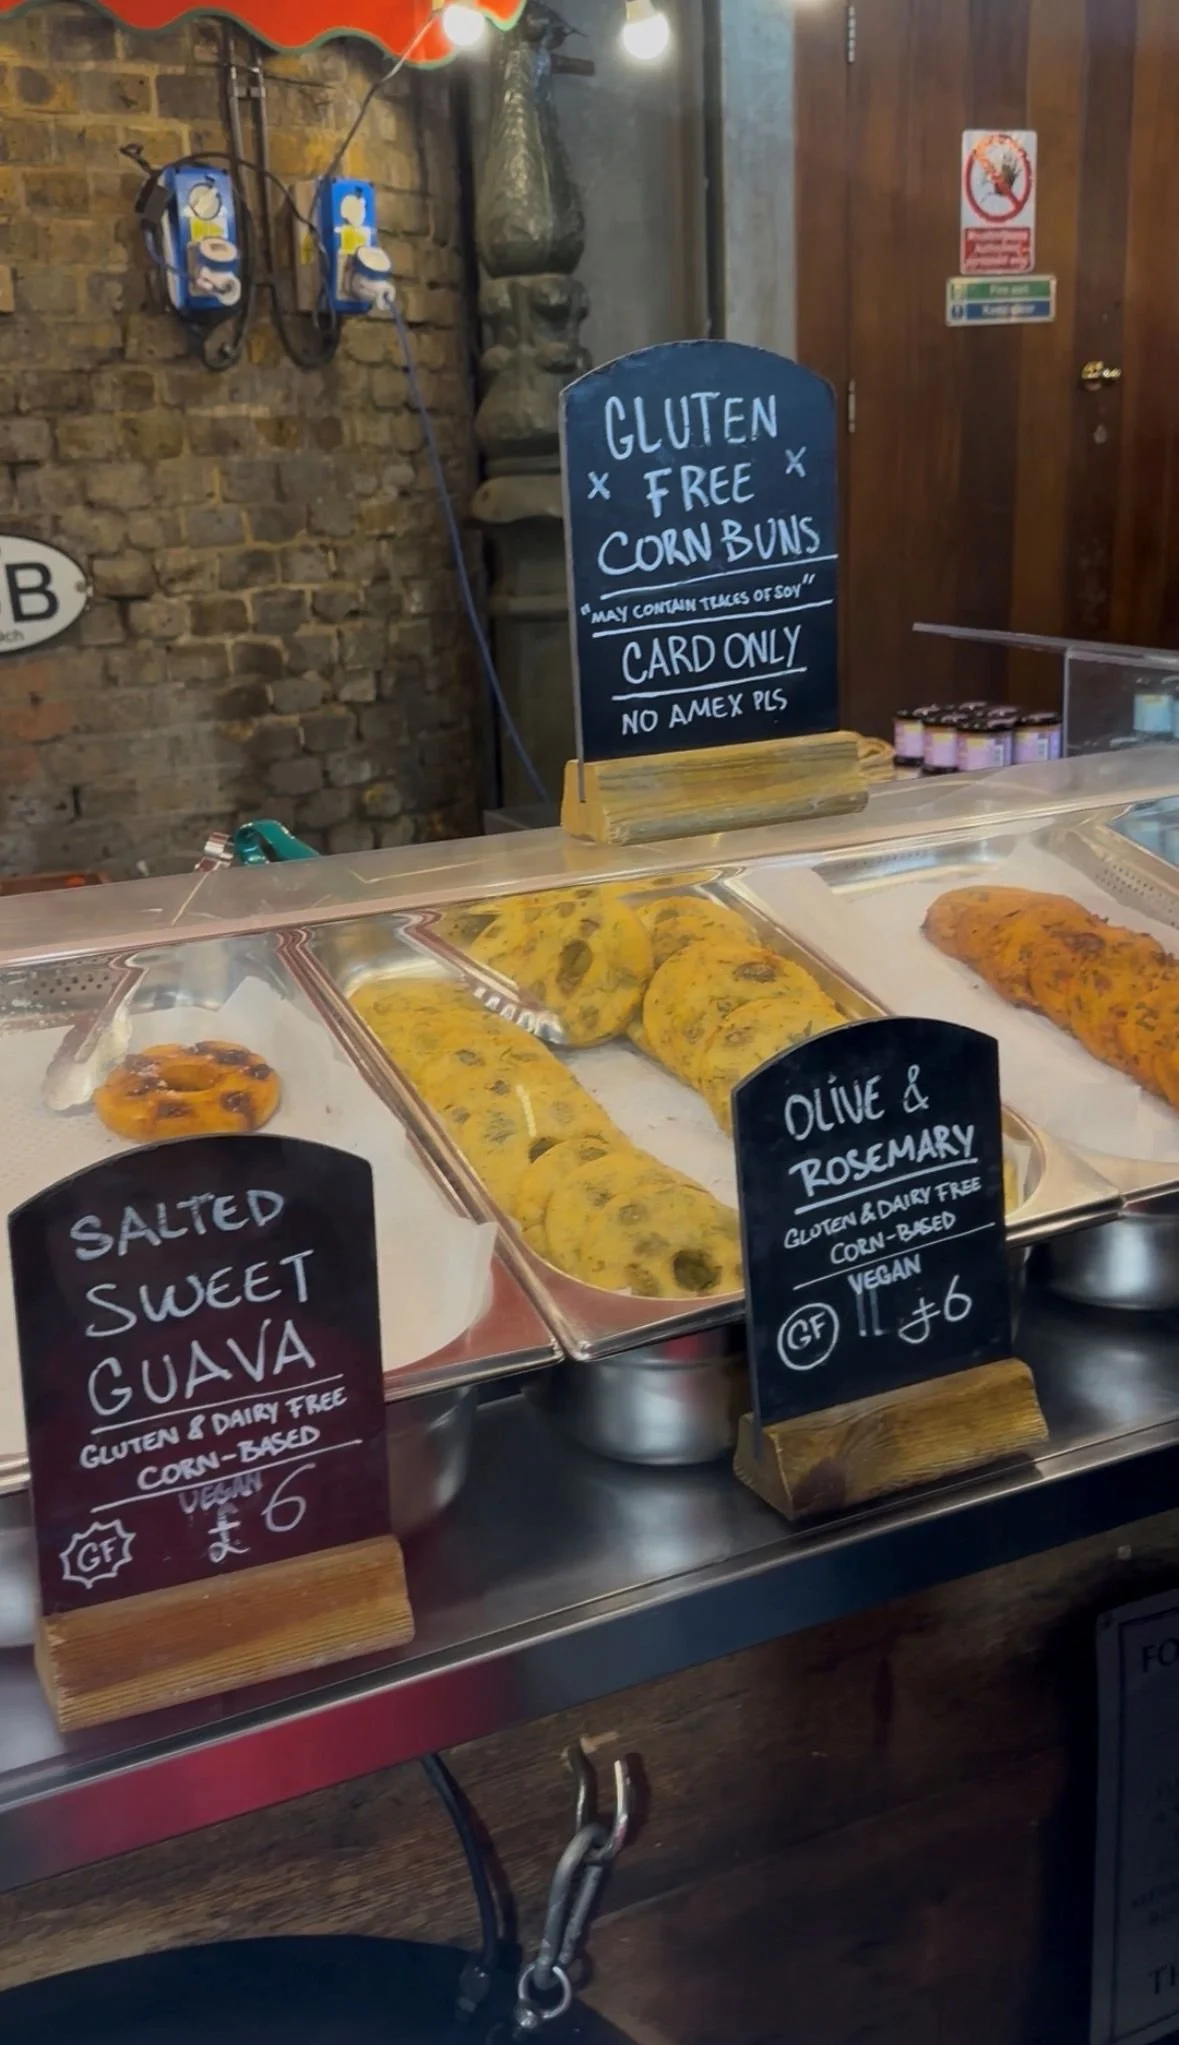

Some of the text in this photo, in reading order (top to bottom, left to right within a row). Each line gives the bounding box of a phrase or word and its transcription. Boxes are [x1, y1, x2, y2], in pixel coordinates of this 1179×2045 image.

[604, 391, 778, 461] GLUTEN
[643, 462, 755, 519] FREE
[597, 514, 820, 576] CORN BUNS
[0, 562, 59, 623] B
[632, 598, 697, 619] CONTAIN
[699, 591, 750, 611] TRACES
[753, 588, 772, 602] OF
[622, 624, 802, 685] CARD ONLY
[621, 688, 789, 736] NO AMEX PLS
[903, 1064, 930, 1114] &
[788, 1124, 975, 1198] ROSEMARY
[69, 1188, 285, 1262] SALTED
[783, 1176, 983, 1249] GLUTEN & DAIRY FREE
[830, 1210, 957, 1265] CORN-BASED
[84, 1248, 315, 1338] SWEET
[847, 1253, 923, 1296] VEGAN
[786, 1311, 828, 1351] GF
[87, 1317, 318, 1417] GUAVA
[79, 1427, 181, 1470] GLUTEN
[211, 1402, 279, 1436] DAIRY
[284, 1385, 349, 1419] FREE
[136, 1424, 321, 1492] CORN-BASED
[177, 1470, 265, 1515] VEGAN
[75, 1536, 119, 1573] GF
